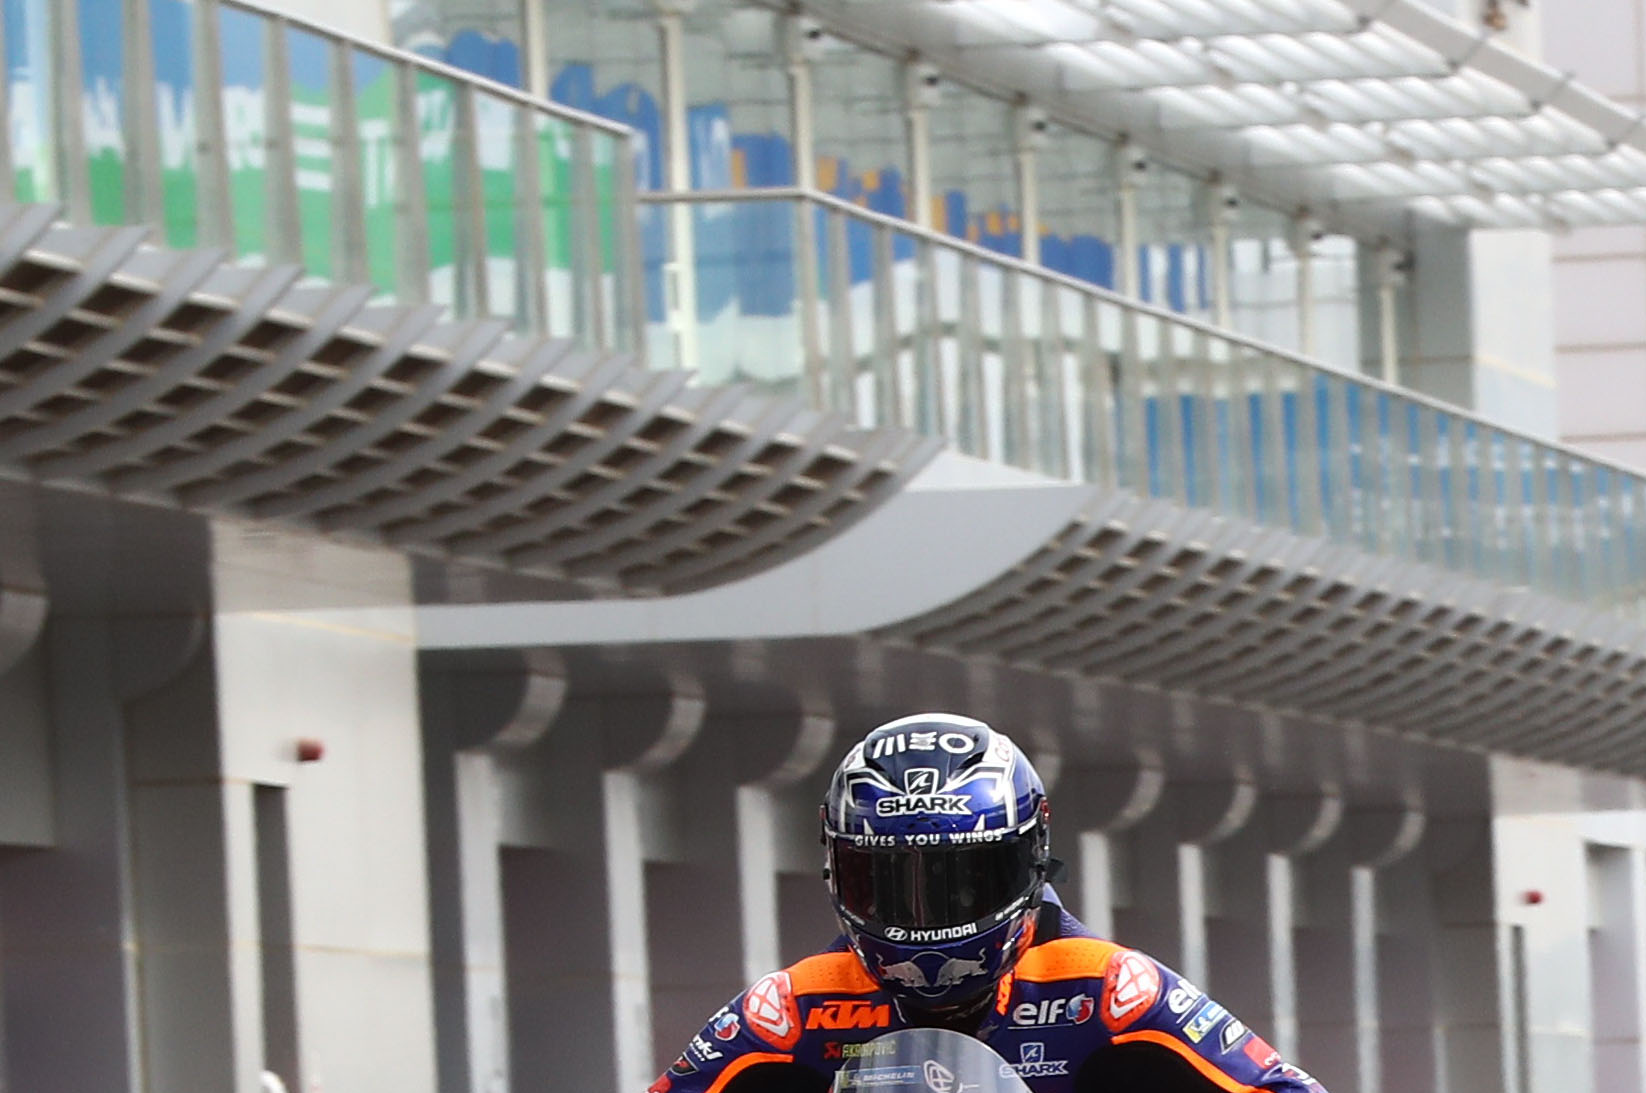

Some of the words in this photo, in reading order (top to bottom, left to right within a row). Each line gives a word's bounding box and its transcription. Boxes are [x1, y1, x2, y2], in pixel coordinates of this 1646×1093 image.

[877, 795, 967, 815] SHARK
[854, 834, 896, 848] GIVES
[905, 834, 941, 847] YOU
[949, 830, 1005, 845] WINGS
[909, 922, 979, 942] HYUNDAI
[805, 999, 890, 1030] KTM
[1012, 997, 1067, 1027] elf
[999, 1058, 1070, 1077] SHARK
